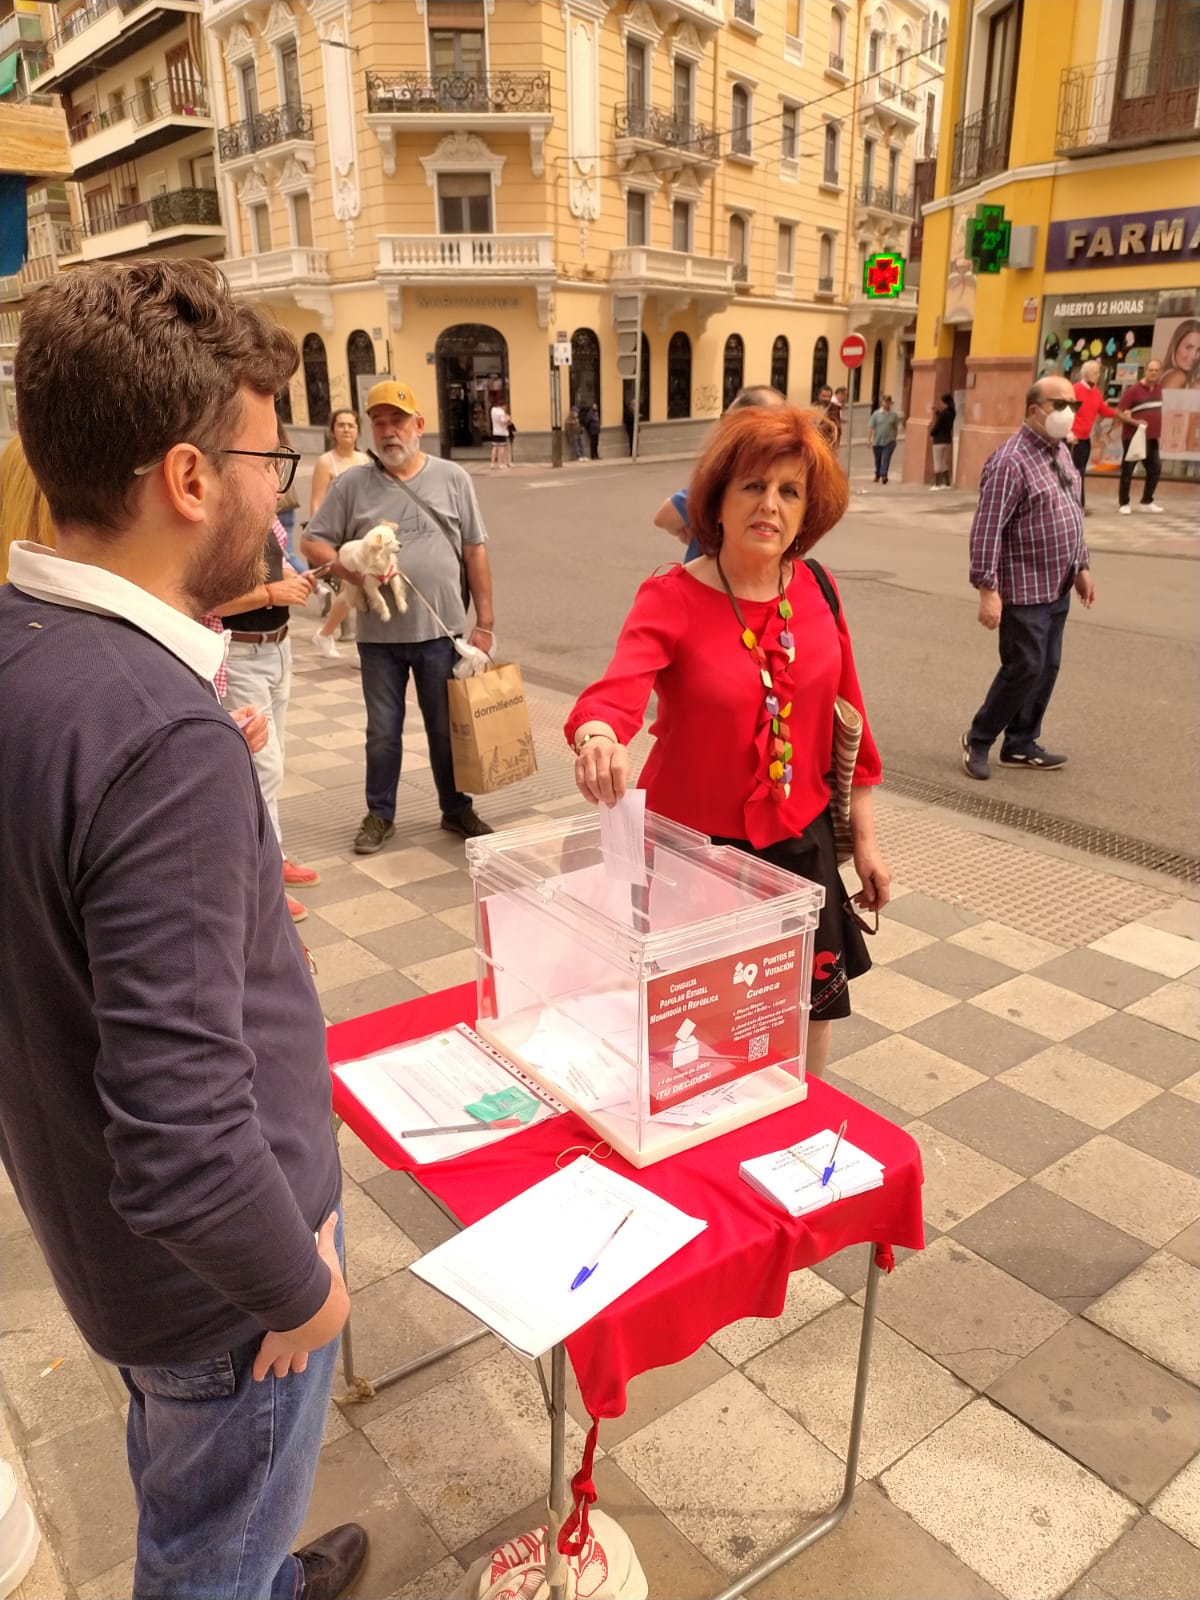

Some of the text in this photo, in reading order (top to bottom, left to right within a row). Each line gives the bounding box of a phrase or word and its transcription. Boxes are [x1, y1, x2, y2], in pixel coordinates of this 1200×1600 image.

[1054, 300, 1144, 317] ABIERTO 12 HORAS
[670, 978, 697, 993] CONSULTA
[746, 981, 781, 999] Cuenca
[659, 986, 708, 1009] POPULAR ESTATAL
[688, 994, 719, 1010] REPÚBLICA
